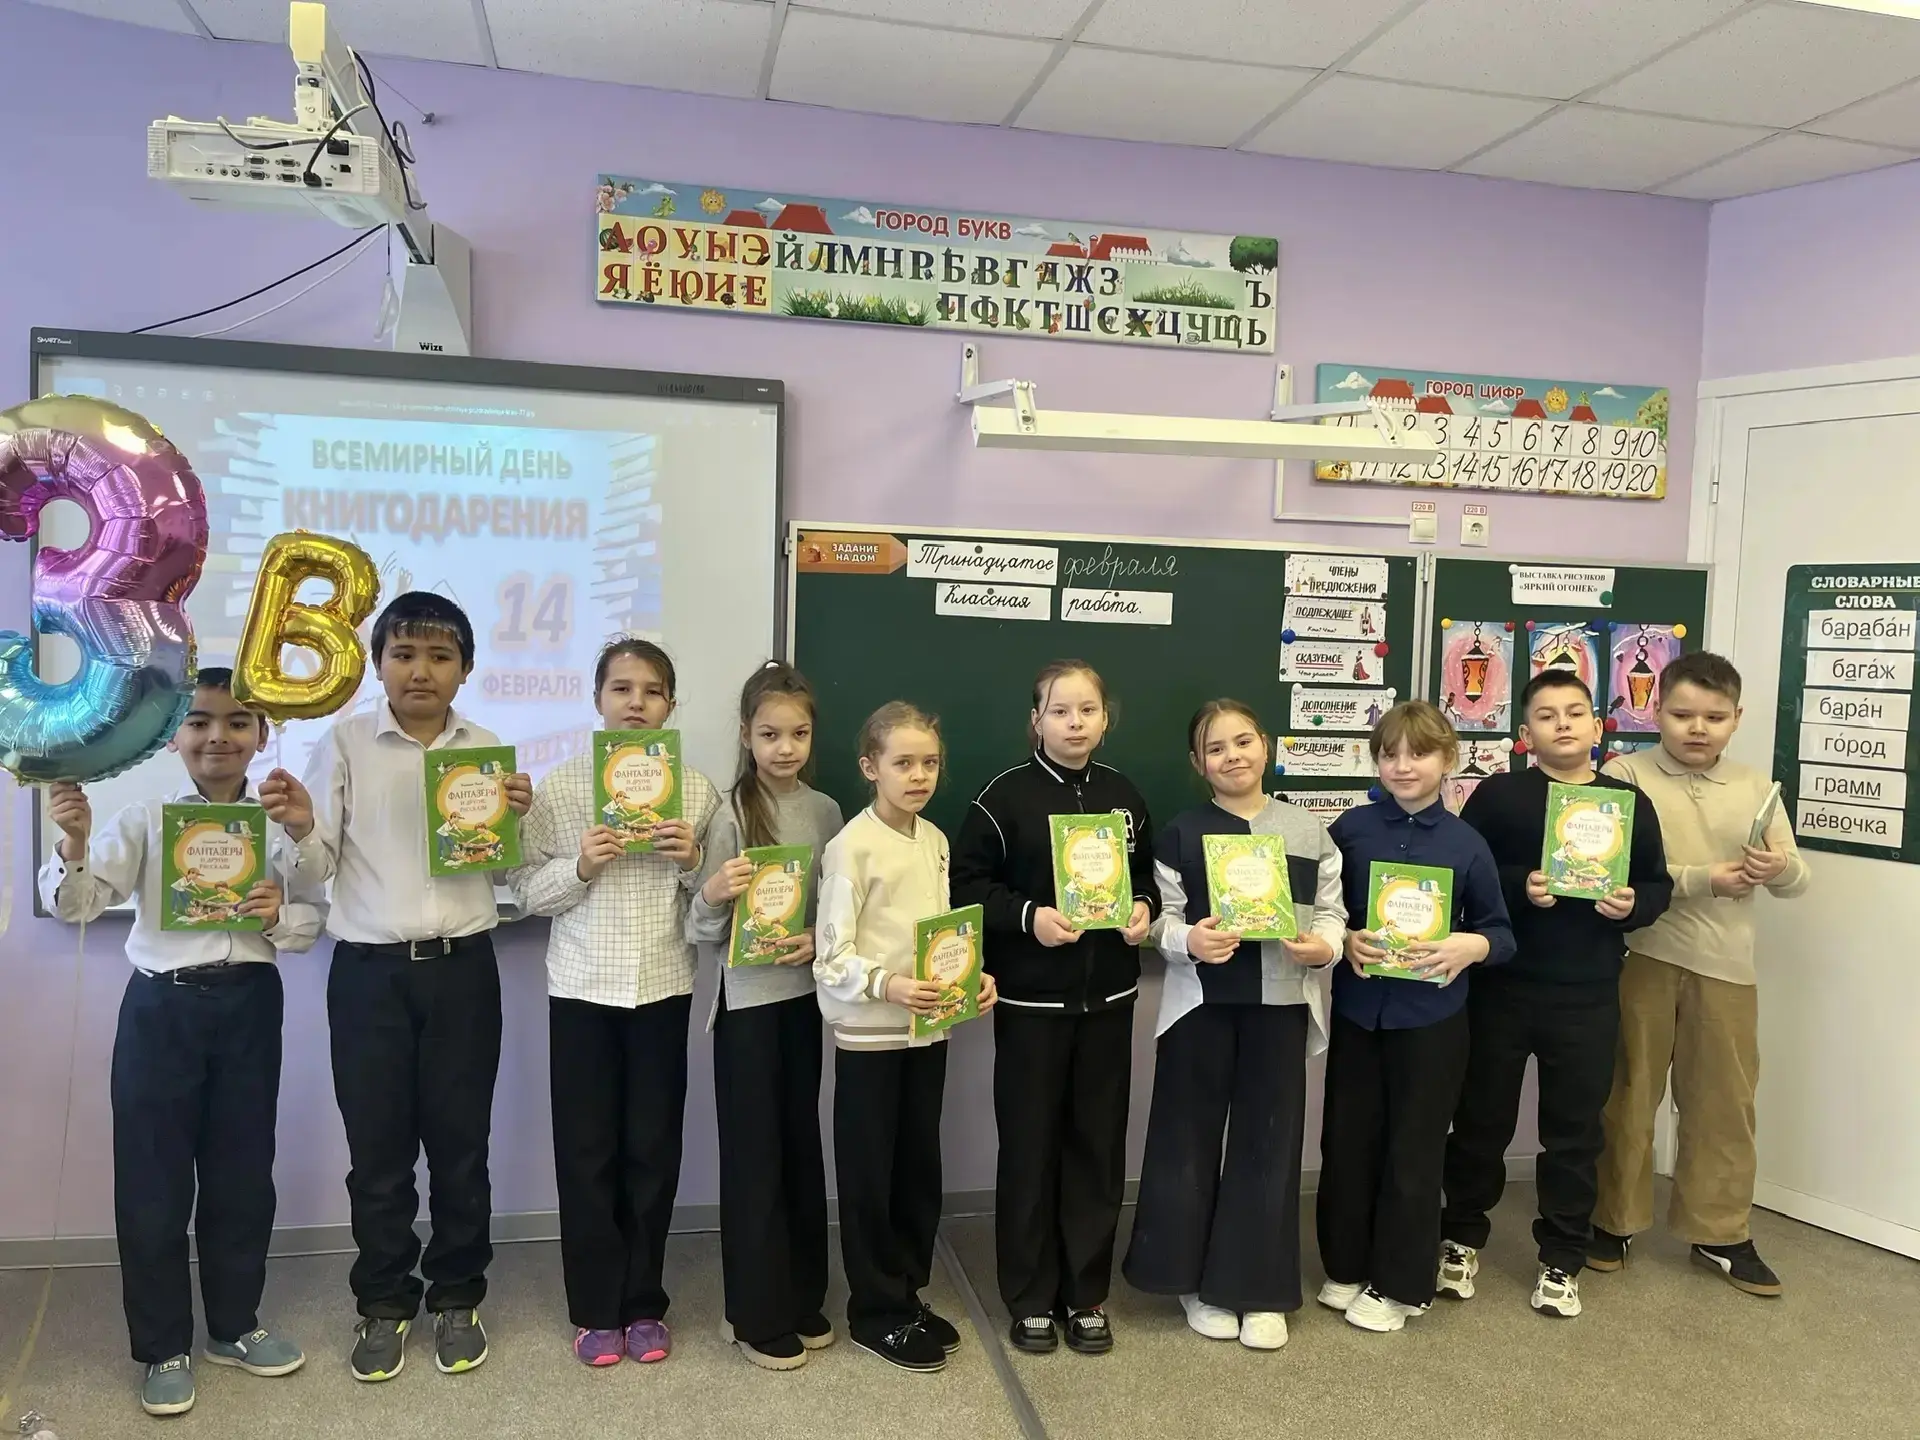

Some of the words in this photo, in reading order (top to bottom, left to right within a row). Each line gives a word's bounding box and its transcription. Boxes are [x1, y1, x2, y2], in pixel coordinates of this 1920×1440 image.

[875, 210, 949, 238] ГОРОД
[957, 218, 1012, 241] БУКВ
[1425, 380, 1475, 400] ГОРОД
[1480, 384, 1525, 400] ЦИФР
[1434, 417, 1448, 445] 3
[1464, 416, 1480, 448] 4
[1488, 421, 1508, 447] 5
[1523, 423, 1541, 451] 6
[1550, 424, 1568, 452] 7
[1582, 427, 1599, 455] 8
[1613, 429, 1628, 457] 9
[1630, 430, 1658, 458] 10
[311, 439, 493, 477] ВСЕМИРНЫЙ
[500, 448, 573, 484] ДЕНЬ
[1422, 452, 1447, 479] 13
[1452, 451, 1479, 481] 14
[1481, 455, 1508, 482] 15
[1511, 457, 1538, 486] 16
[1539, 459, 1569, 488] 17
[1572, 460, 1597, 490] 18
[1602, 462, 1626, 491] 19
[1626, 463, 1658, 492] 20
[281, 486, 590, 544] КНИГОДАРЕНИЯ
[1414, 503, 1426, 511] 220
[832, 543, 879, 555] ЗАДАНИЕ
[835, 553, 851, 563] НА
[853, 553, 876, 563] ДОМ
[915, 543, 1055, 577] Тринадцатое
[1064, 544, 1179, 588] февраля
[1328, 566, 1359, 578] ЧЛЕНЫ
[1519, 571, 1562, 581] ВЫСТАВКА
[1563, 573, 1606, 582] РИСУНКОВ
[1811, 576, 1920, 588] СЛОВАРНЫЕ
[944, 583, 1031, 609] Классная
[1309, 580, 1377, 594] ПРЕДЛОЖЕНИЯ
[1835, 595, 1896, 608] СЛОВА
[498, 580, 569, 644] 14
[1295, 606, 1353, 619] ПОДЛЕЖАЩЕЕ
[1295, 653, 1343, 664] СКАЗУЕМОЕ
[482, 672, 583, 698] ФЕВРАЛЯ
[1301, 700, 1357, 711] ДОПОЛНЕНИЕ
[1814, 775, 1881, 799] грамм
